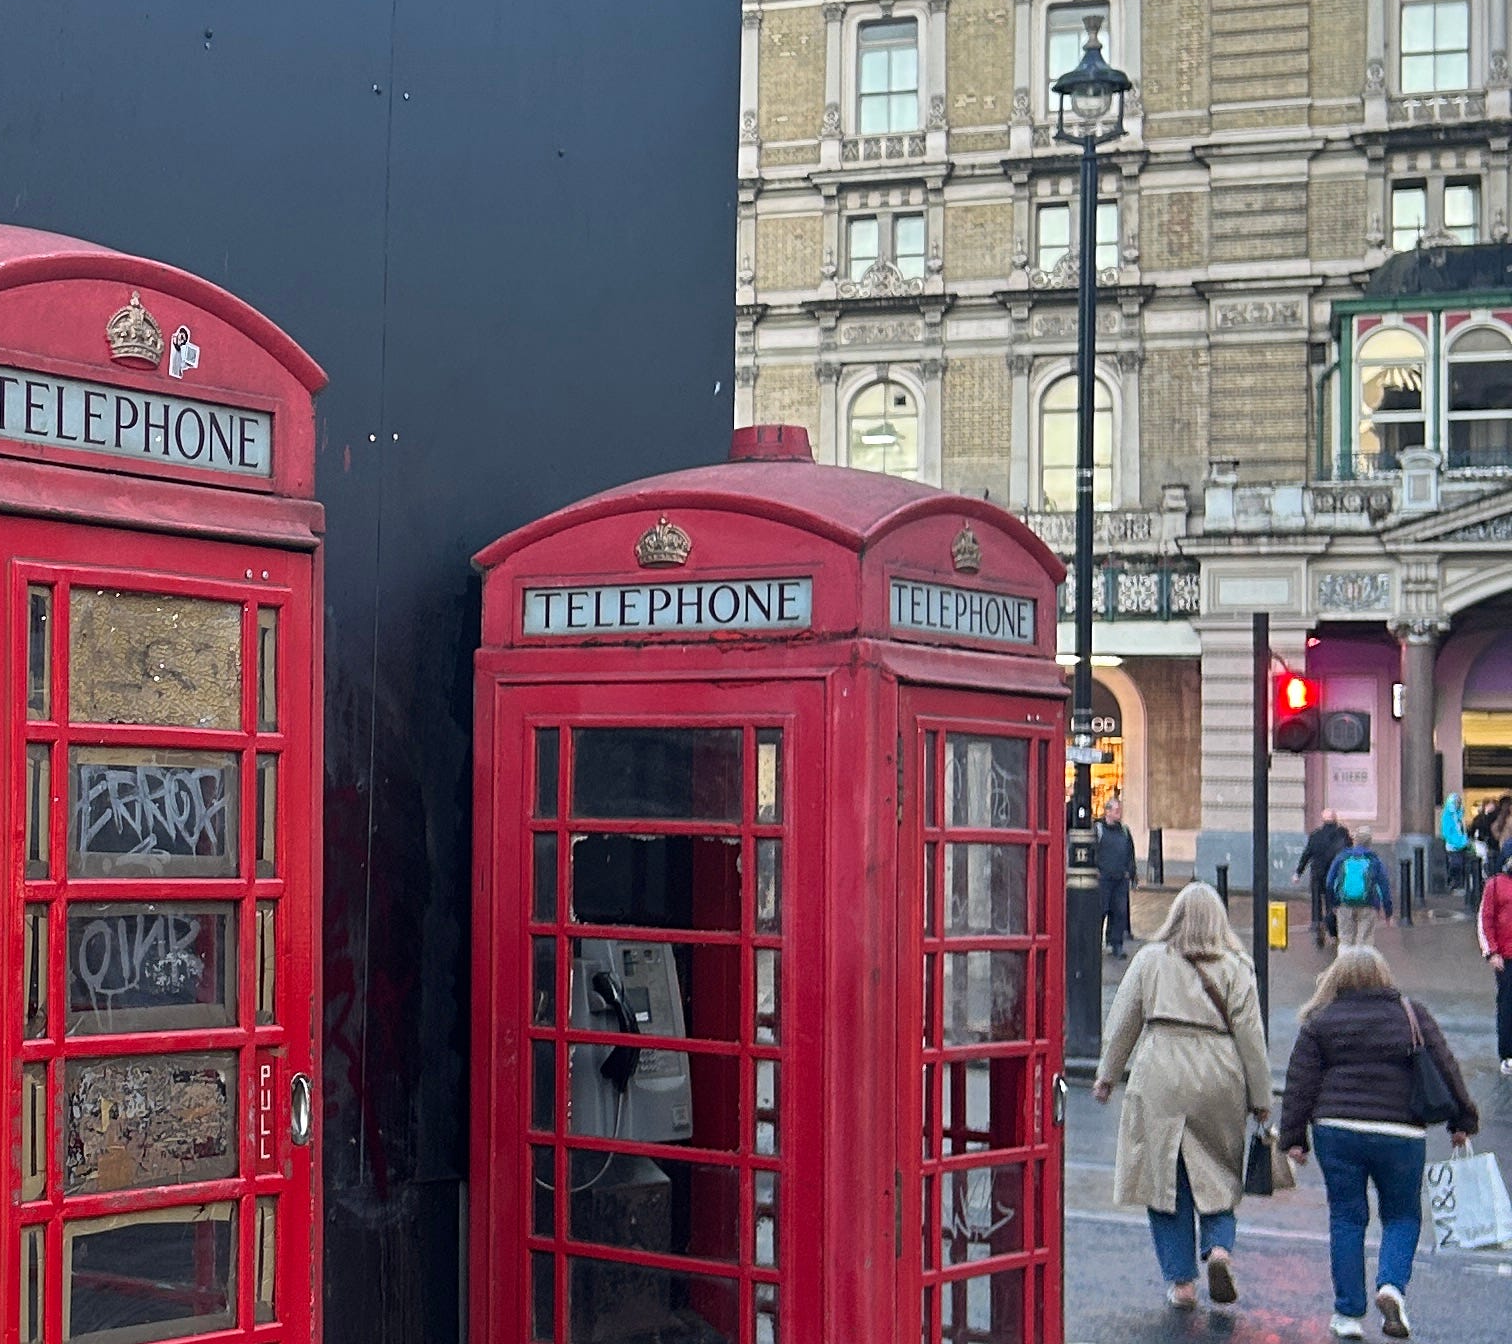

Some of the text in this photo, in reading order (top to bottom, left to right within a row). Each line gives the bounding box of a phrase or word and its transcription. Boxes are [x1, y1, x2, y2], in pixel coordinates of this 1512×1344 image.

[534, 582, 801, 629] TELEPHONE
[892, 583, 1030, 640] TELEPHONE
[260, 1064, 271, 1159] PULL
[1034, 1064, 1042, 1133] PULL
[1427, 1163, 1460, 1247] M&S
